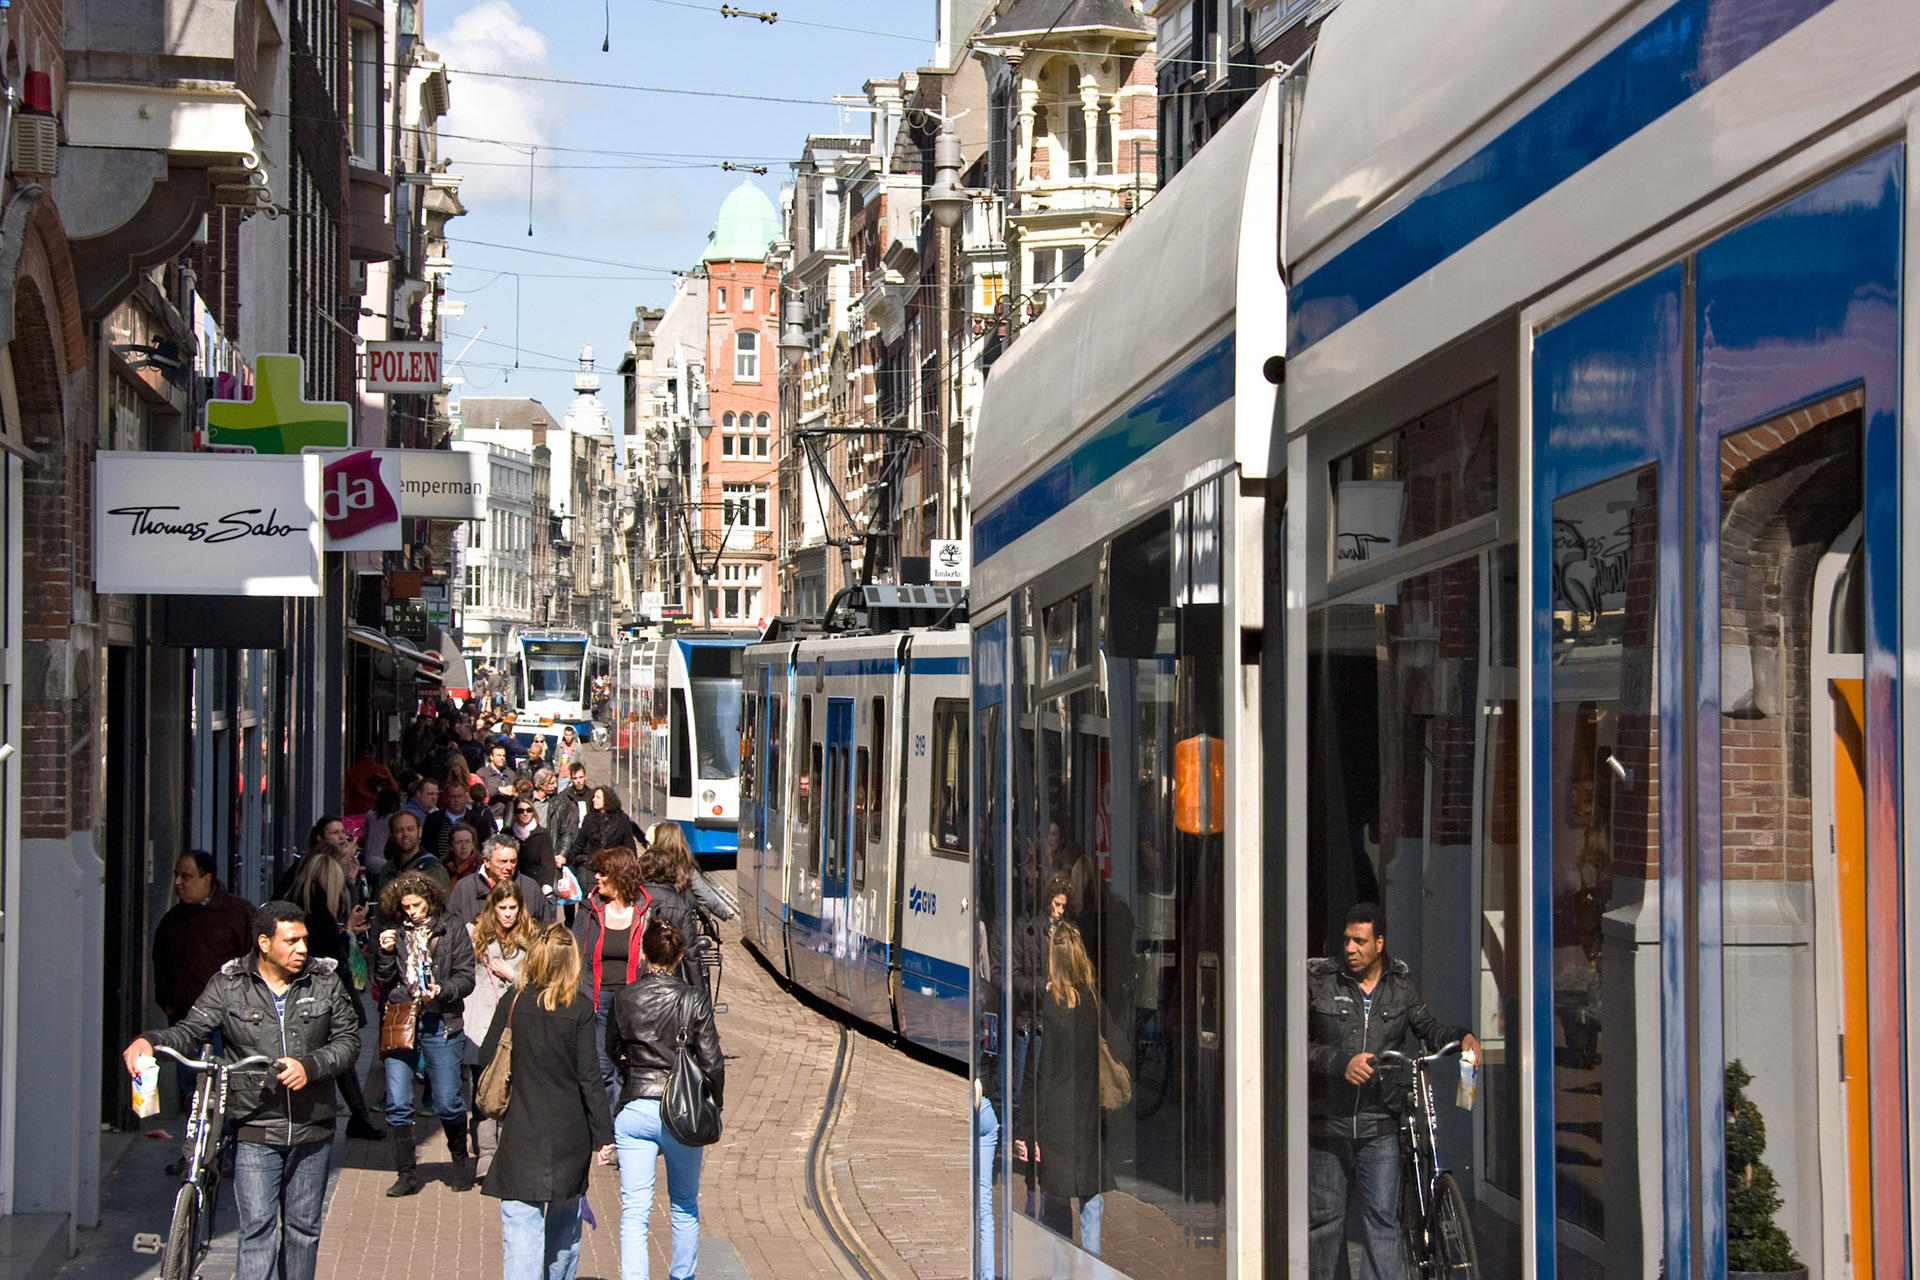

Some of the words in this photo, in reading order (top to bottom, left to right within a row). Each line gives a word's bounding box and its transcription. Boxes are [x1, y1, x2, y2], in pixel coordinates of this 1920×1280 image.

[369, 350, 439, 383] POLEN
[324, 472, 374, 521] da
[107, 506, 209, 541] Thomas
[204, 508, 308, 543] Sabo
[915, 734, 926, 757] 919
[921, 891, 937, 916] GVB
